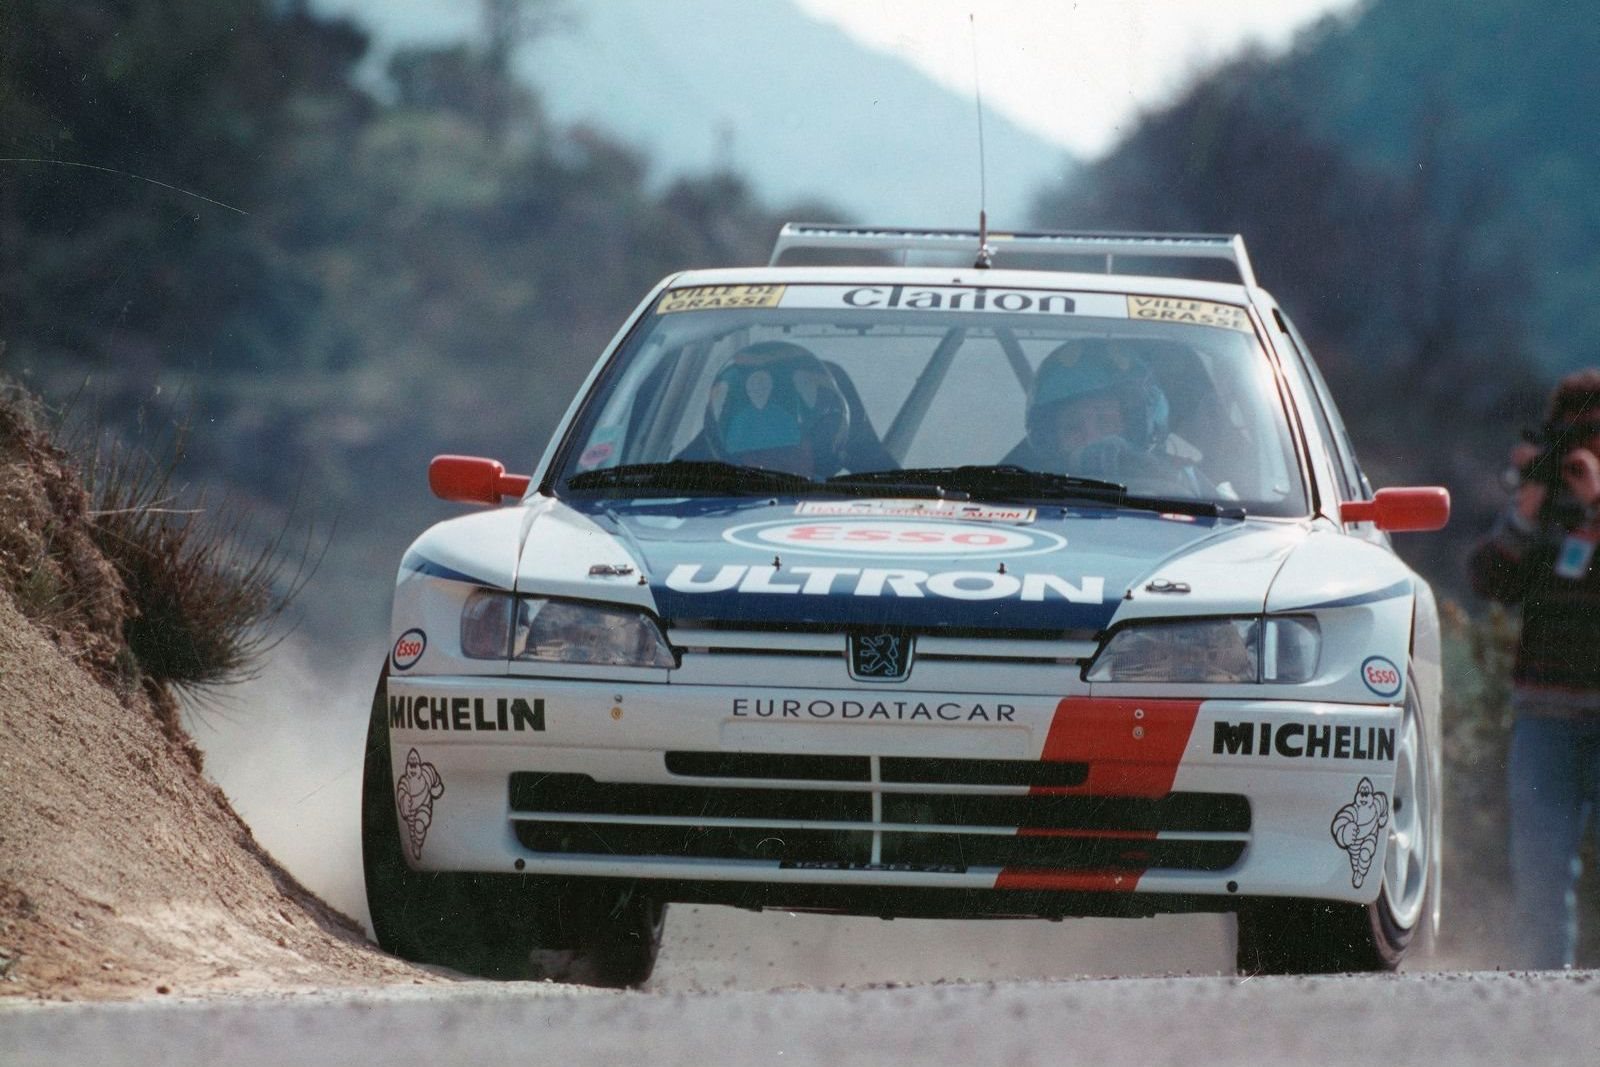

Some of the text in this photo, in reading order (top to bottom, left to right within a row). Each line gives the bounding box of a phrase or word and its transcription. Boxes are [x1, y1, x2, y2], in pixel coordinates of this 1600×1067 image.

[665, 296, 773, 311] GRASSE
[672, 285, 777, 299] VILLE DE
[842, 285, 1076, 313] Clarion
[1135, 298, 1201, 312] VILLE
[1137, 308, 1244, 328] GRASSE
[664, 563, 1105, 605] ULTRON
[389, 695, 546, 732] MICHELIN
[732, 698, 1016, 722] EURODATACAR
[1212, 720, 1396, 761] MICHELIN
